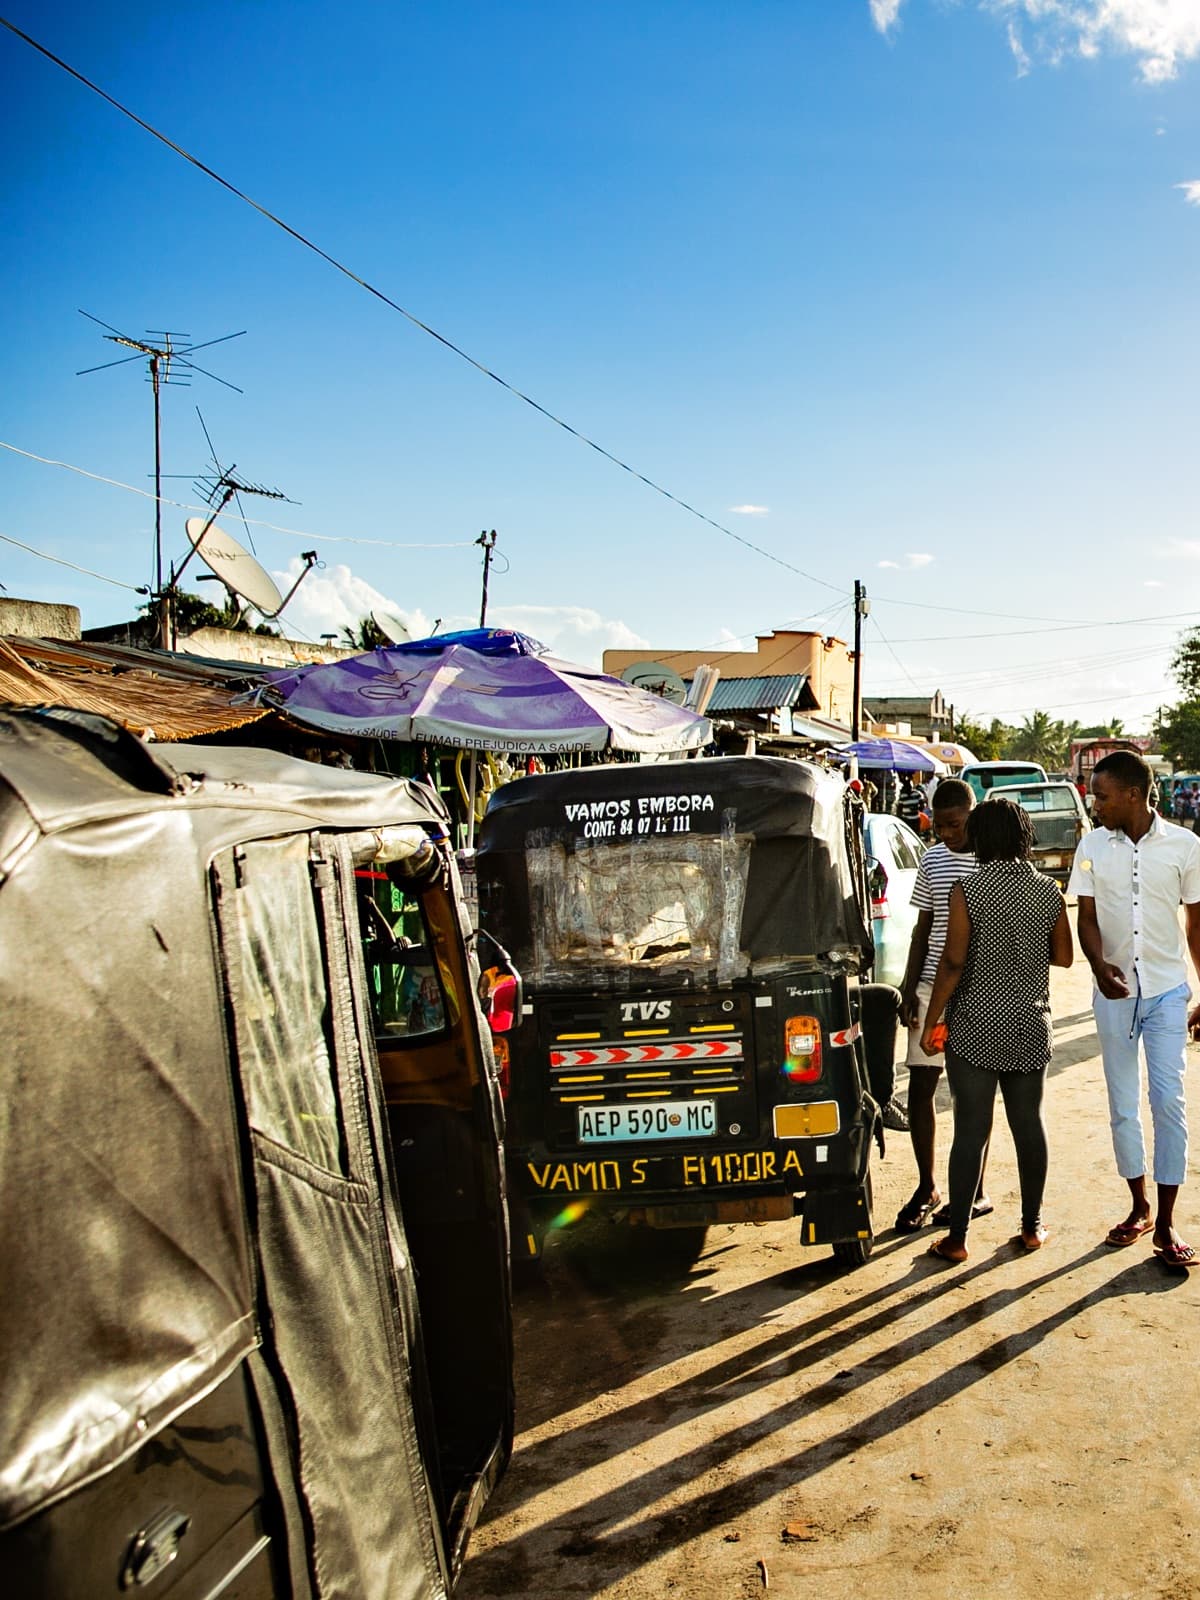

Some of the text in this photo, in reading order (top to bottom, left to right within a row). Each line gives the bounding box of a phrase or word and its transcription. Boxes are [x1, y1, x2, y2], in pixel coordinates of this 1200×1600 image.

[465, 737, 536, 751] PREJUDICA
[536, 741, 546, 752] A
[564, 794, 714, 822] VAMOS EMBORA
[584, 820, 616, 838] CONT:
[620, 818, 633, 835] 84
[638, 817, 651, 834] 07
[672, 815, 691, 832] 111
[620, 1000, 672, 1022] TVS
[582, 1105, 713, 1137] AEP 590 MC
